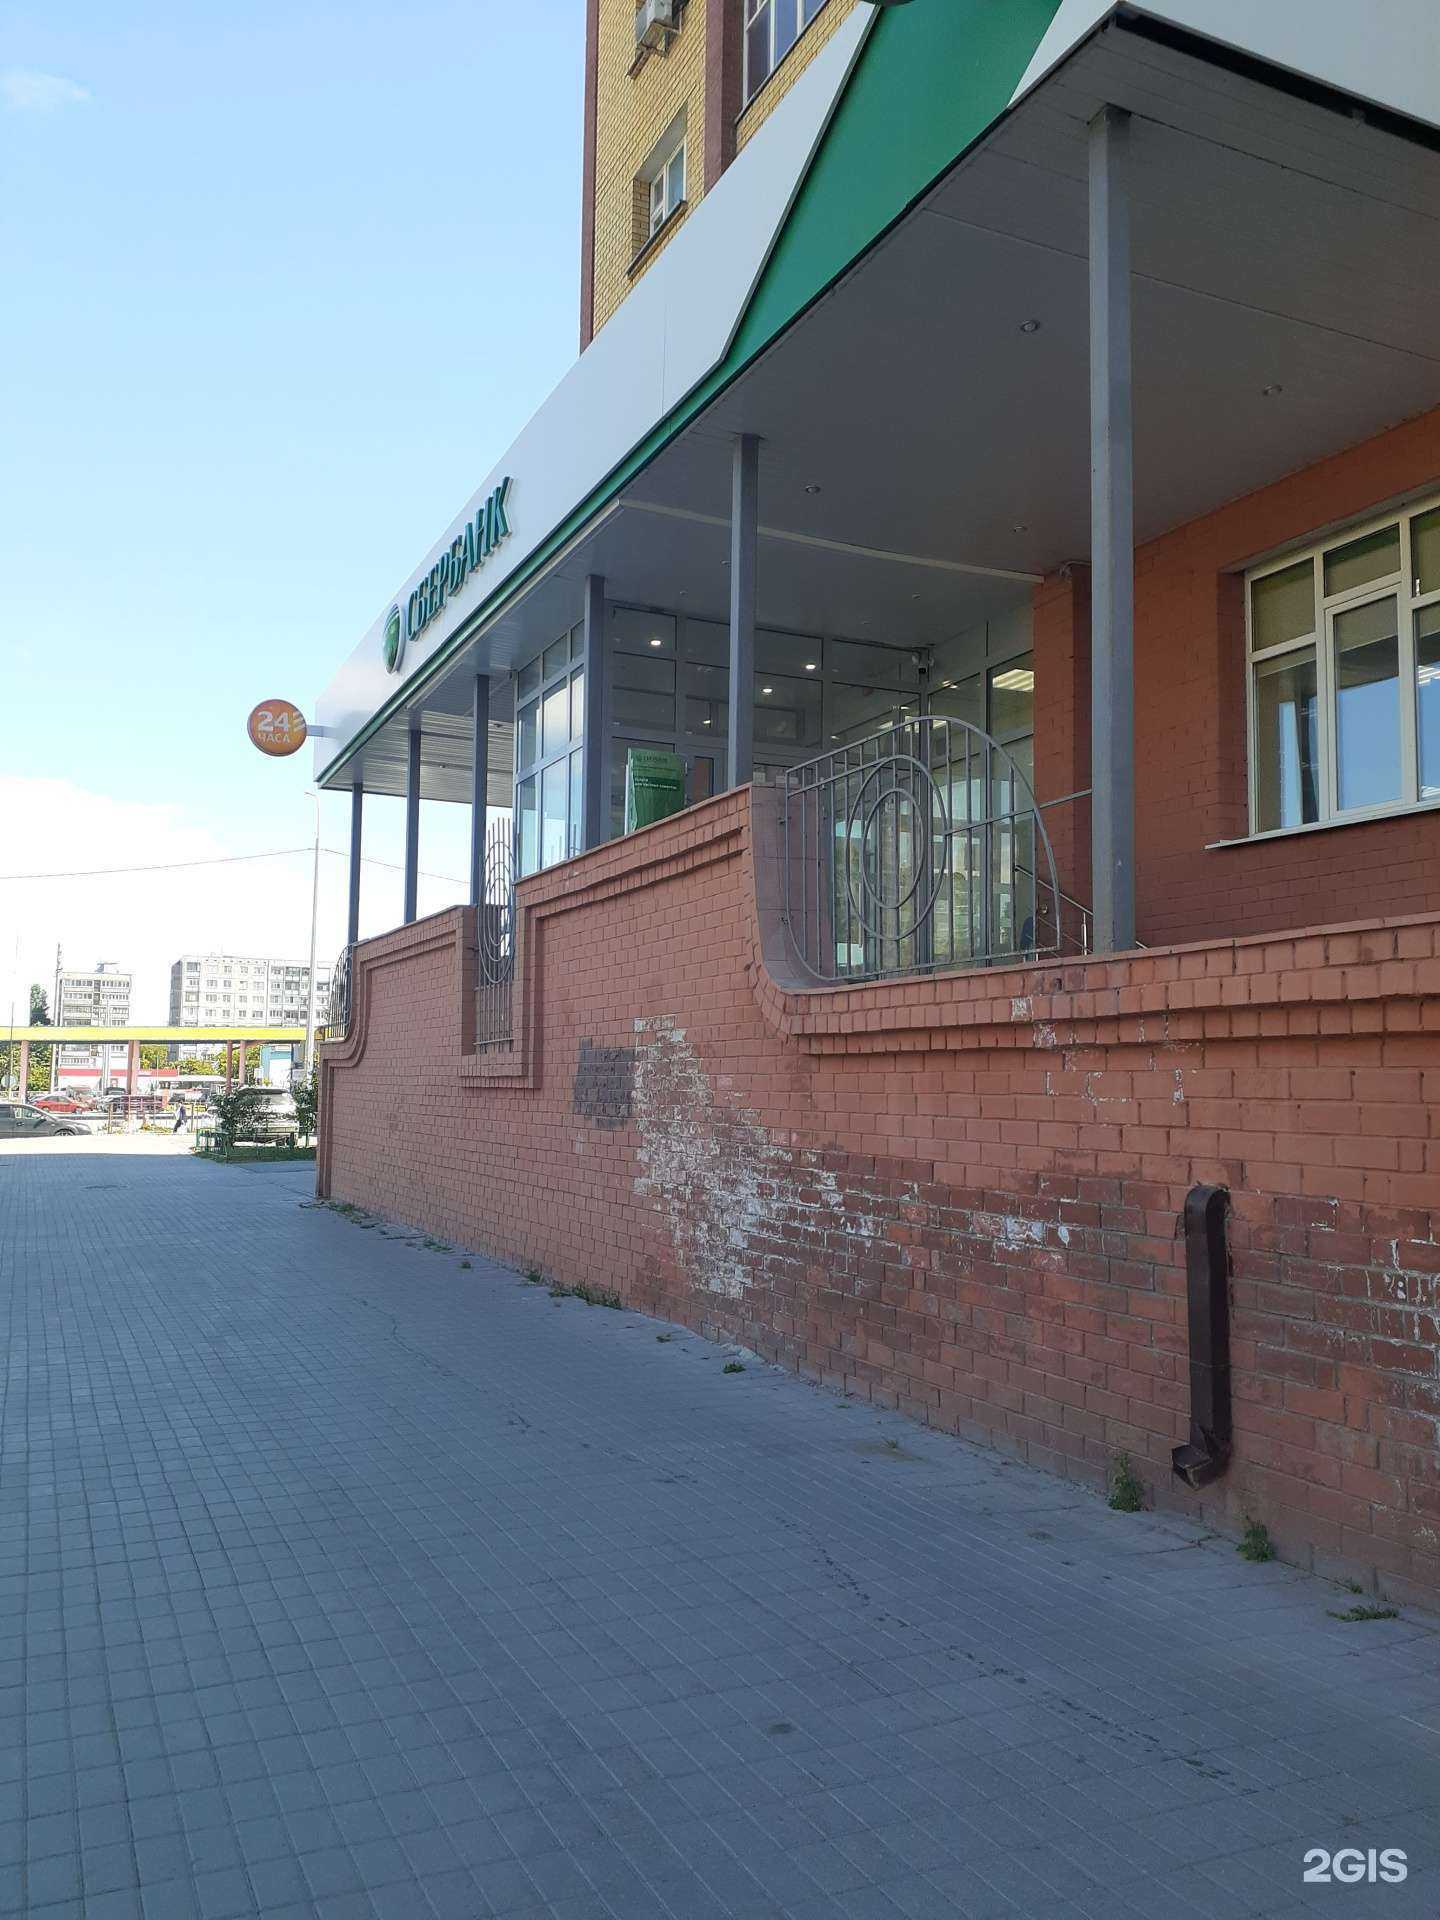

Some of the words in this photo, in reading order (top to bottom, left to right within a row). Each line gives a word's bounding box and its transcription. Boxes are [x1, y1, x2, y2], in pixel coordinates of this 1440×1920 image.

[408, 476, 512, 642] СБЕРБАНК
[258, 711, 288, 732] 24
[258, 732, 290, 743] ЧАСА
